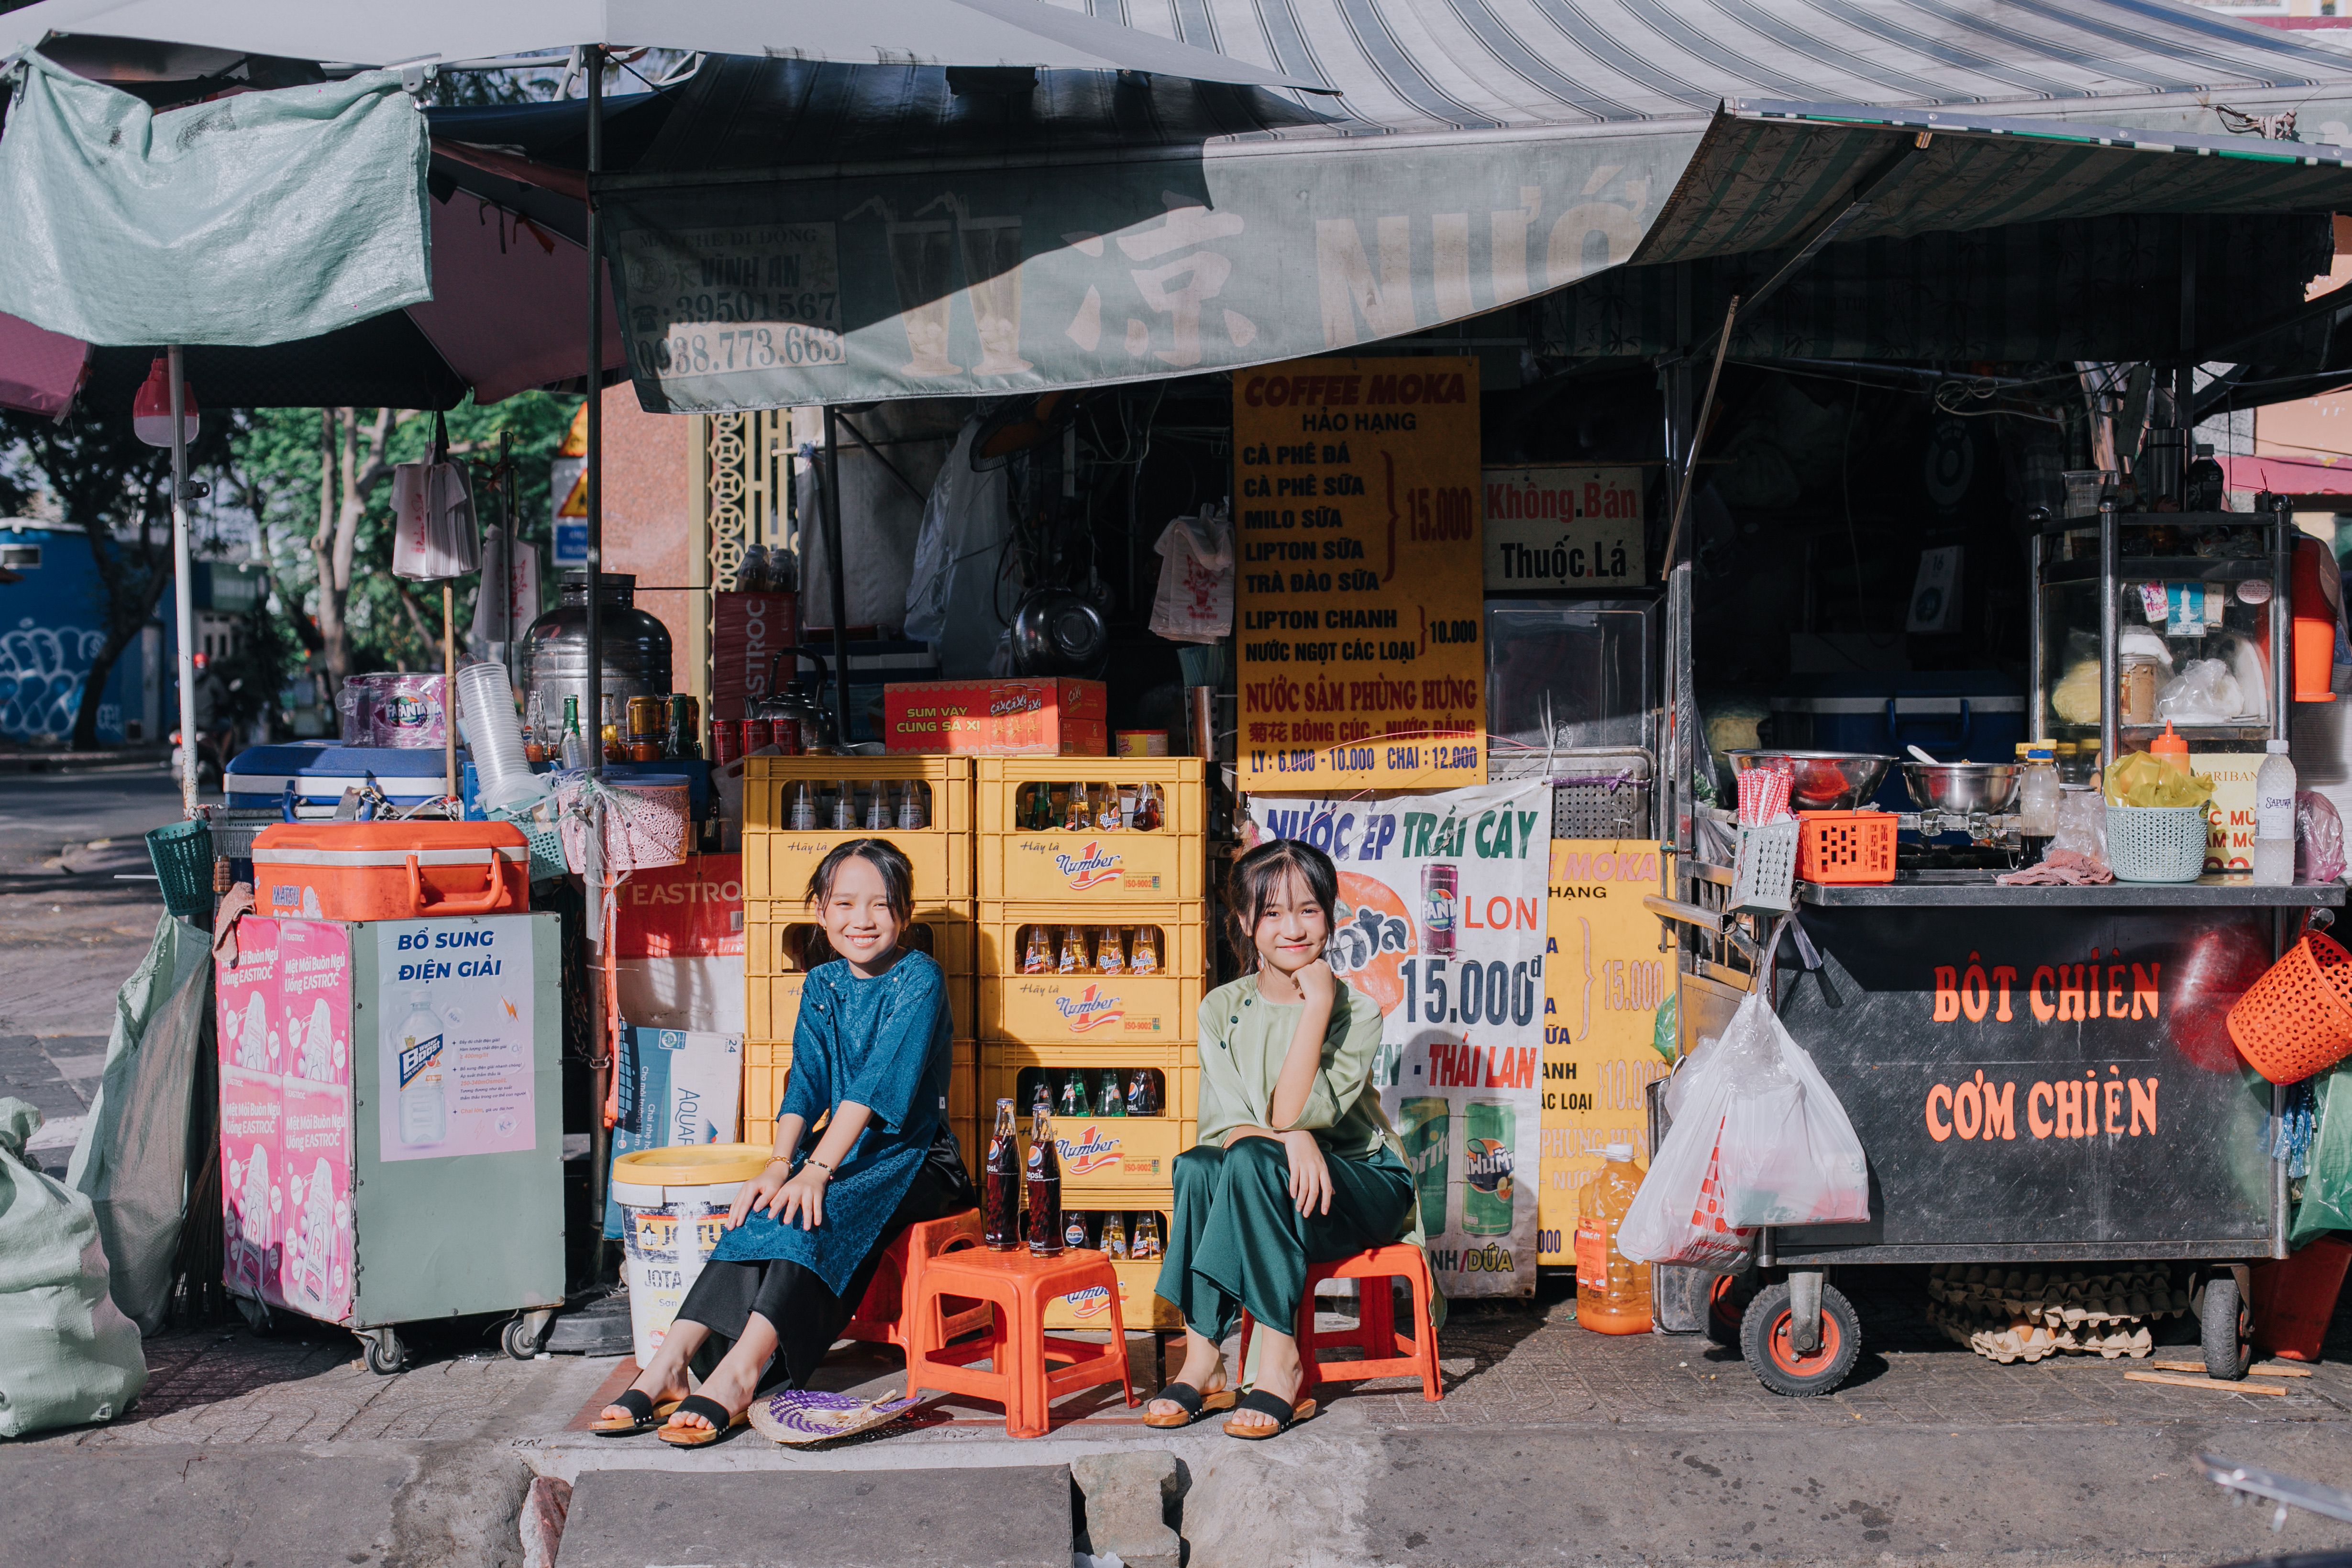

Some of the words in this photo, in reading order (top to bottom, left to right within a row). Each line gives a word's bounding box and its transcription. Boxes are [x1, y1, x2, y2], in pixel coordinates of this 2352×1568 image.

[700, 253, 759, 287] VĨNH
[768, 254, 801, 287] AN
[638, 326, 840, 378] 0938.773.663
[1245, 375, 1362, 407] COFFEE
[1367, 373, 1466, 405] MOKA
[1303, 406, 1348, 431] HẢO
[1356, 413, 1416, 434] HẠNG
[1244, 443, 1271, 464] CÀ
[1277, 442, 1316, 464] PHÊ
[1323, 442, 1350, 463] ĐÁ
[1244, 475, 1271, 497] CÀ
[1278, 474, 1317, 496] PHÊ
[1324, 473, 1364, 495] SỮA
[1245, 510, 1295, 529] MILO
[1302, 506, 1343, 528] SỮA
[1407, 487, 1472, 541] 15.000
[1246, 541, 1316, 561] LIPTON
[1324, 537, 1364, 560] SỮA
[1246, 571, 1284, 593] TRÀ
[1291, 570, 1331, 592] ĐÀO
[1338, 569, 1379, 591] SỮA
[1246, 610, 1318, 629] LIPTON
[1326, 609, 1397, 628] CHANH
[1430, 621, 1477, 643] 10.000
[1246, 640, 1290, 662] NƯỚC
[1295, 642, 1336, 664] NGỌT
[1342, 638, 1374, 660] CÁC
[1380, 642, 1415, 664] LOẠI
[1246, 674, 1299, 713] NƯỚC
[1305, 674, 1344, 712] SÂM
[1350, 673, 1417, 711] PHÙNG
[1422, 674, 1478, 709] HƯNG
[398, 702, 425, 717] FANTA
[907, 707, 936, 718] SUM
[896, 720, 937, 733] CÙNG
[942, 718, 962, 732] SÁ
[966, 720, 980, 732] XỊ
[1248, 722, 1288, 743] 菊花
[1292, 719, 1335, 742] BÔNG
[1339, 718, 1369, 741] CÚC
[1387, 718, 1428, 740] NƯỚC
[1433, 713, 1476, 740] ĐẮNG
[1279, 749, 1316, 772] 6.000
[1330, 748, 1374, 771] 10.000
[1432, 746, 1478, 769] 12.000
[1266, 797, 1355, 861] NƯỚC
[1358, 798, 1396, 861] ÉP
[1402, 805, 1467, 859] TRÁI
[1475, 800, 1538, 859] CÂY
[788, 842, 813, 854] Hãy
[817, 842, 827, 850] là
[1020, 841, 1045, 854] Hãy
[1049, 842, 1060, 851] là
[1055, 848, 1121, 875] Number
[1562, 852, 1658, 881] MOKA
[1125, 879, 1152, 888] ISO-9002
[1548, 886, 1607, 901] HẠNG
[273, 885, 300, 906] MATSU
[1465, 895, 1537, 930] LON
[287, 933, 305, 942] EASTROC
[398, 927, 429, 950] BỔ
[435, 930, 494, 949] SUNG
[247, 949, 264, 965] Buồn
[265, 946, 278, 965] Ngủ
[285, 958, 298, 975] Mệt
[299, 956, 311, 973] Mỏi
[312, 955, 330, 971] Buồn
[331, 951, 345, 971] Ngủ
[239, 966, 273, 984] EASTROC
[398, 959, 452, 984] ĐIỆN
[458, 954, 502, 977] GIẢI
[303, 972, 339, 990] EASTROC
[1020, 983, 1045, 997] Hãy
[1049, 985, 1059, 994] là
[1602, 960, 1665, 1011] 15.000
[1055, 990, 1120, 1017] Number
[1125, 1021, 1152, 1030] ISO-9002
[1545, 1025, 1571, 1044] ỮA
[419, 1038, 438, 1052] Water
[729, 1039, 738, 1053] 24
[1428, 1032, 1482, 1087] THÁI
[1485, 1047, 1537, 1089] LAN
[288, 1090, 306, 1099] EASTROC
[1561, 1093, 1592, 1114] LOẠI
[1926, 1069, 2016, 1142] CƠM
[226, 1102, 238, 1117] Mệt
[238, 1102, 250, 1116] Mỏi
[250, 1101, 267, 1116] Buồn
[267, 1101, 281, 1119] Ngủ
[647, 1103, 655, 1122] Chai
[243, 1120, 275, 1134] EASTROC
[287, 1115, 299, 1131] Mệt
[300, 1115, 313, 1130] Mỏi
[313, 1113, 330, 1129] Buồn
[331, 1113, 346, 1131] Ngủ
[305, 1132, 340, 1148] EASTROC
[1055, 1132, 1120, 1160] Number
[1540, 1119, 1603, 1158] PHÙNG
[1125, 1163, 1151, 1171] ISO-9002
[659, 1298, 677, 1307] Sơn
